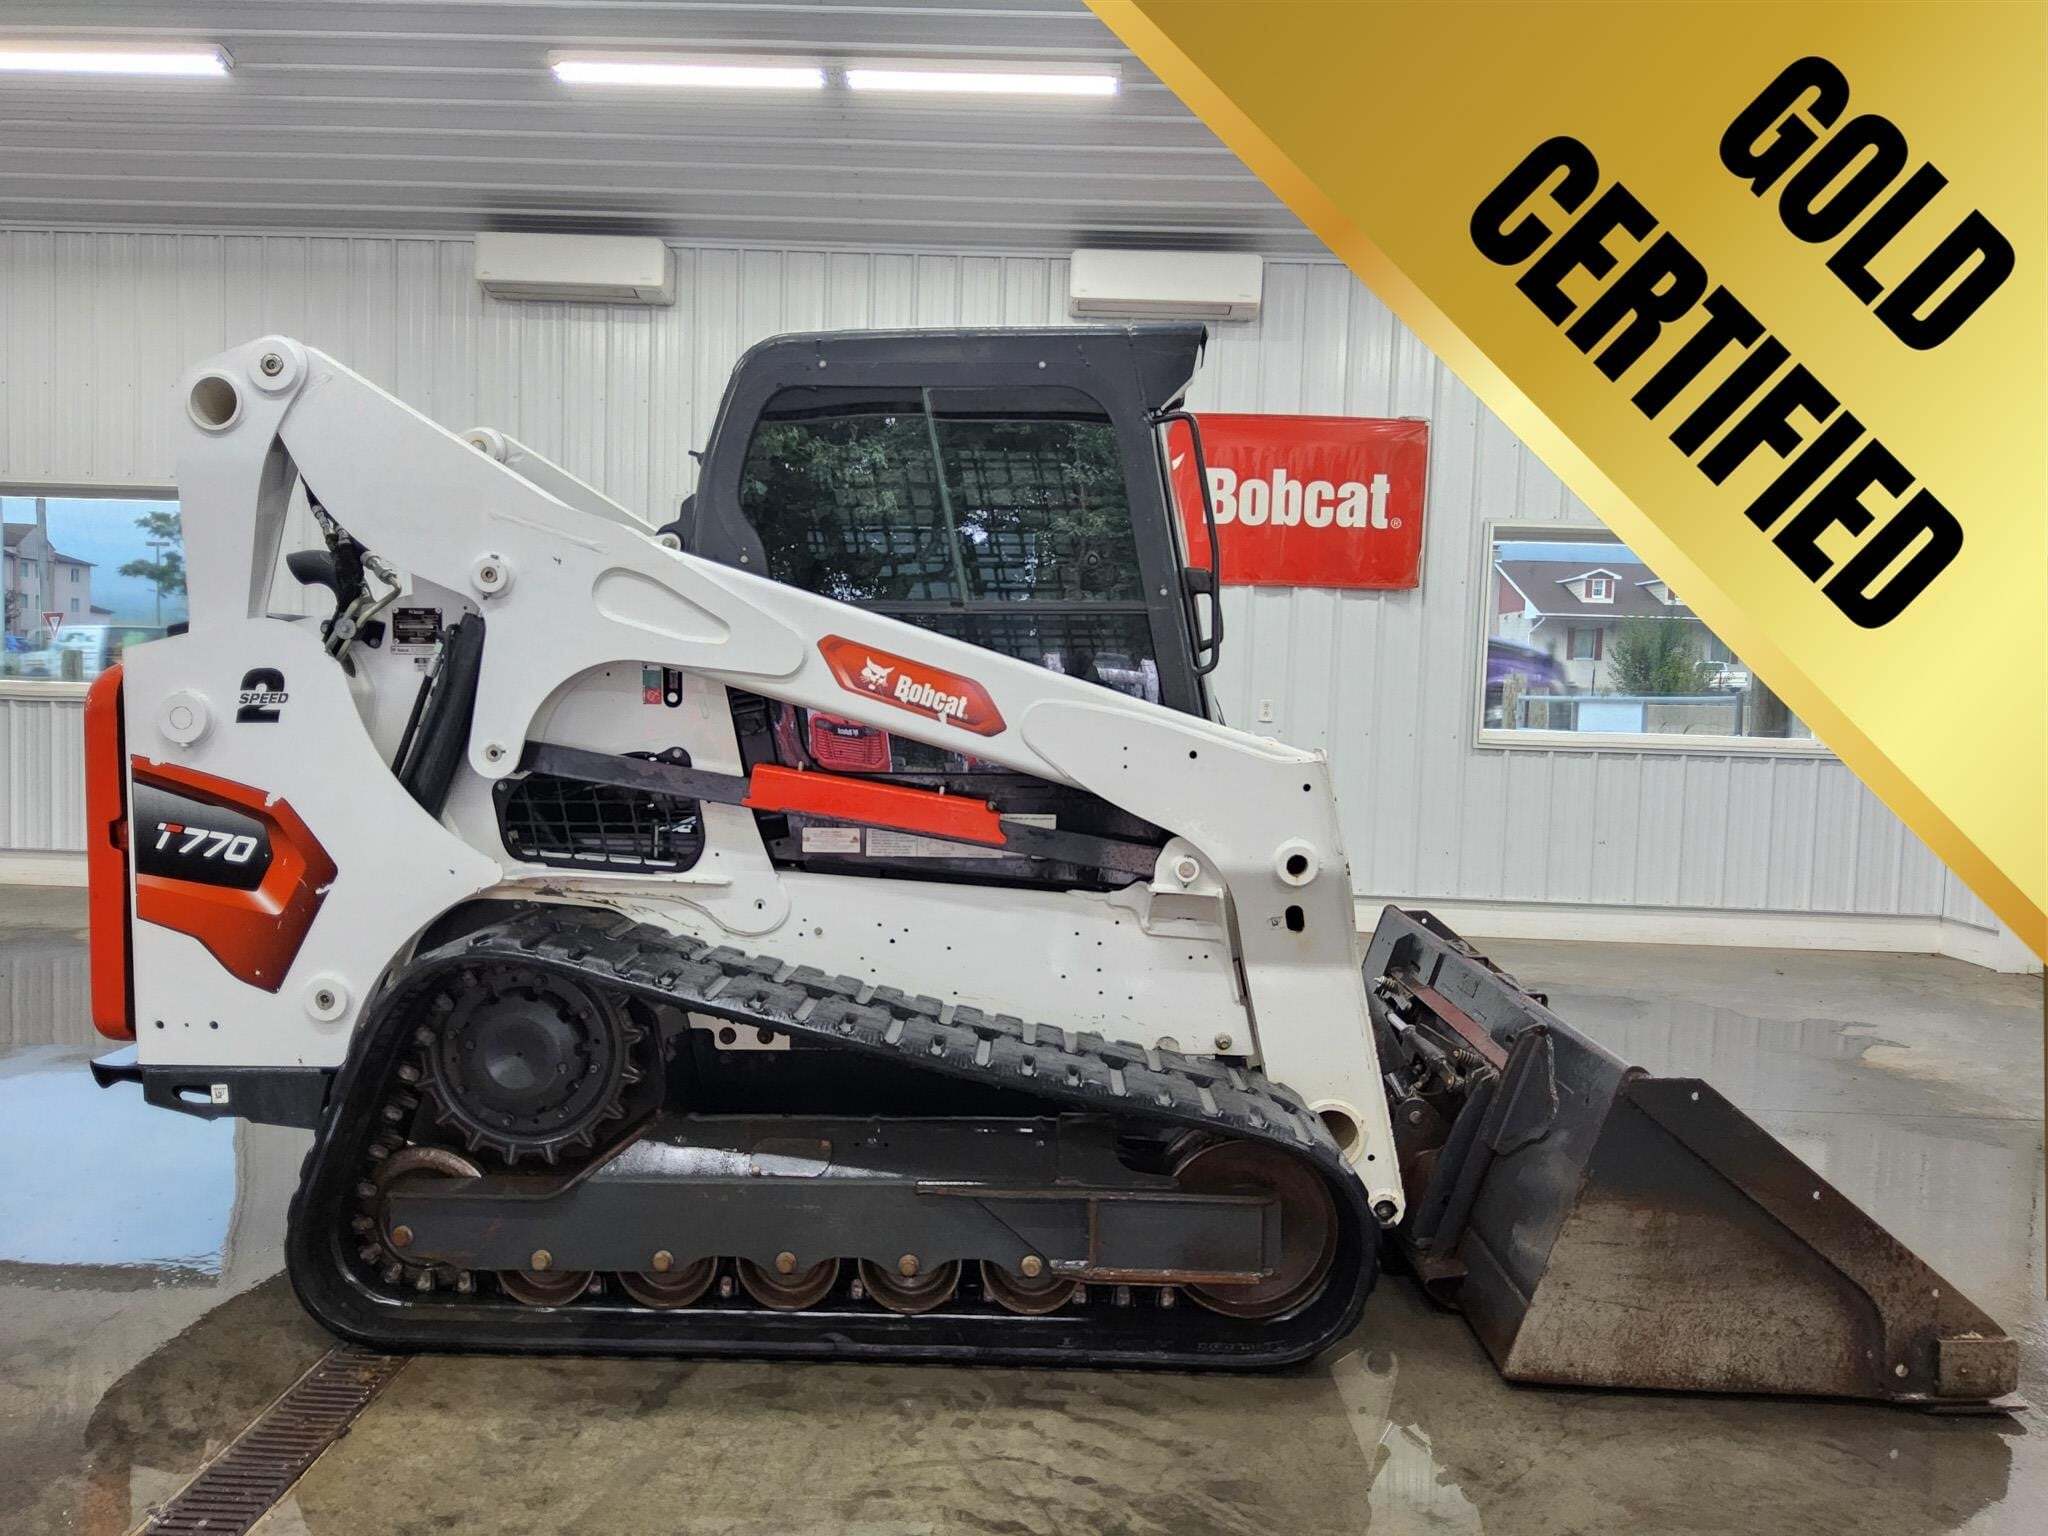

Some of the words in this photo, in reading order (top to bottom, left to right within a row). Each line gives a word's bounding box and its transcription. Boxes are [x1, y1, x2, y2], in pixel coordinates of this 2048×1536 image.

[1203, 467, 1391, 529] Bobcat
[236, 667, 285, 723] 2
[239, 692, 289, 704] SPEED
[893, 674, 969, 719] Bobcat
[155, 822, 258, 862] T770
